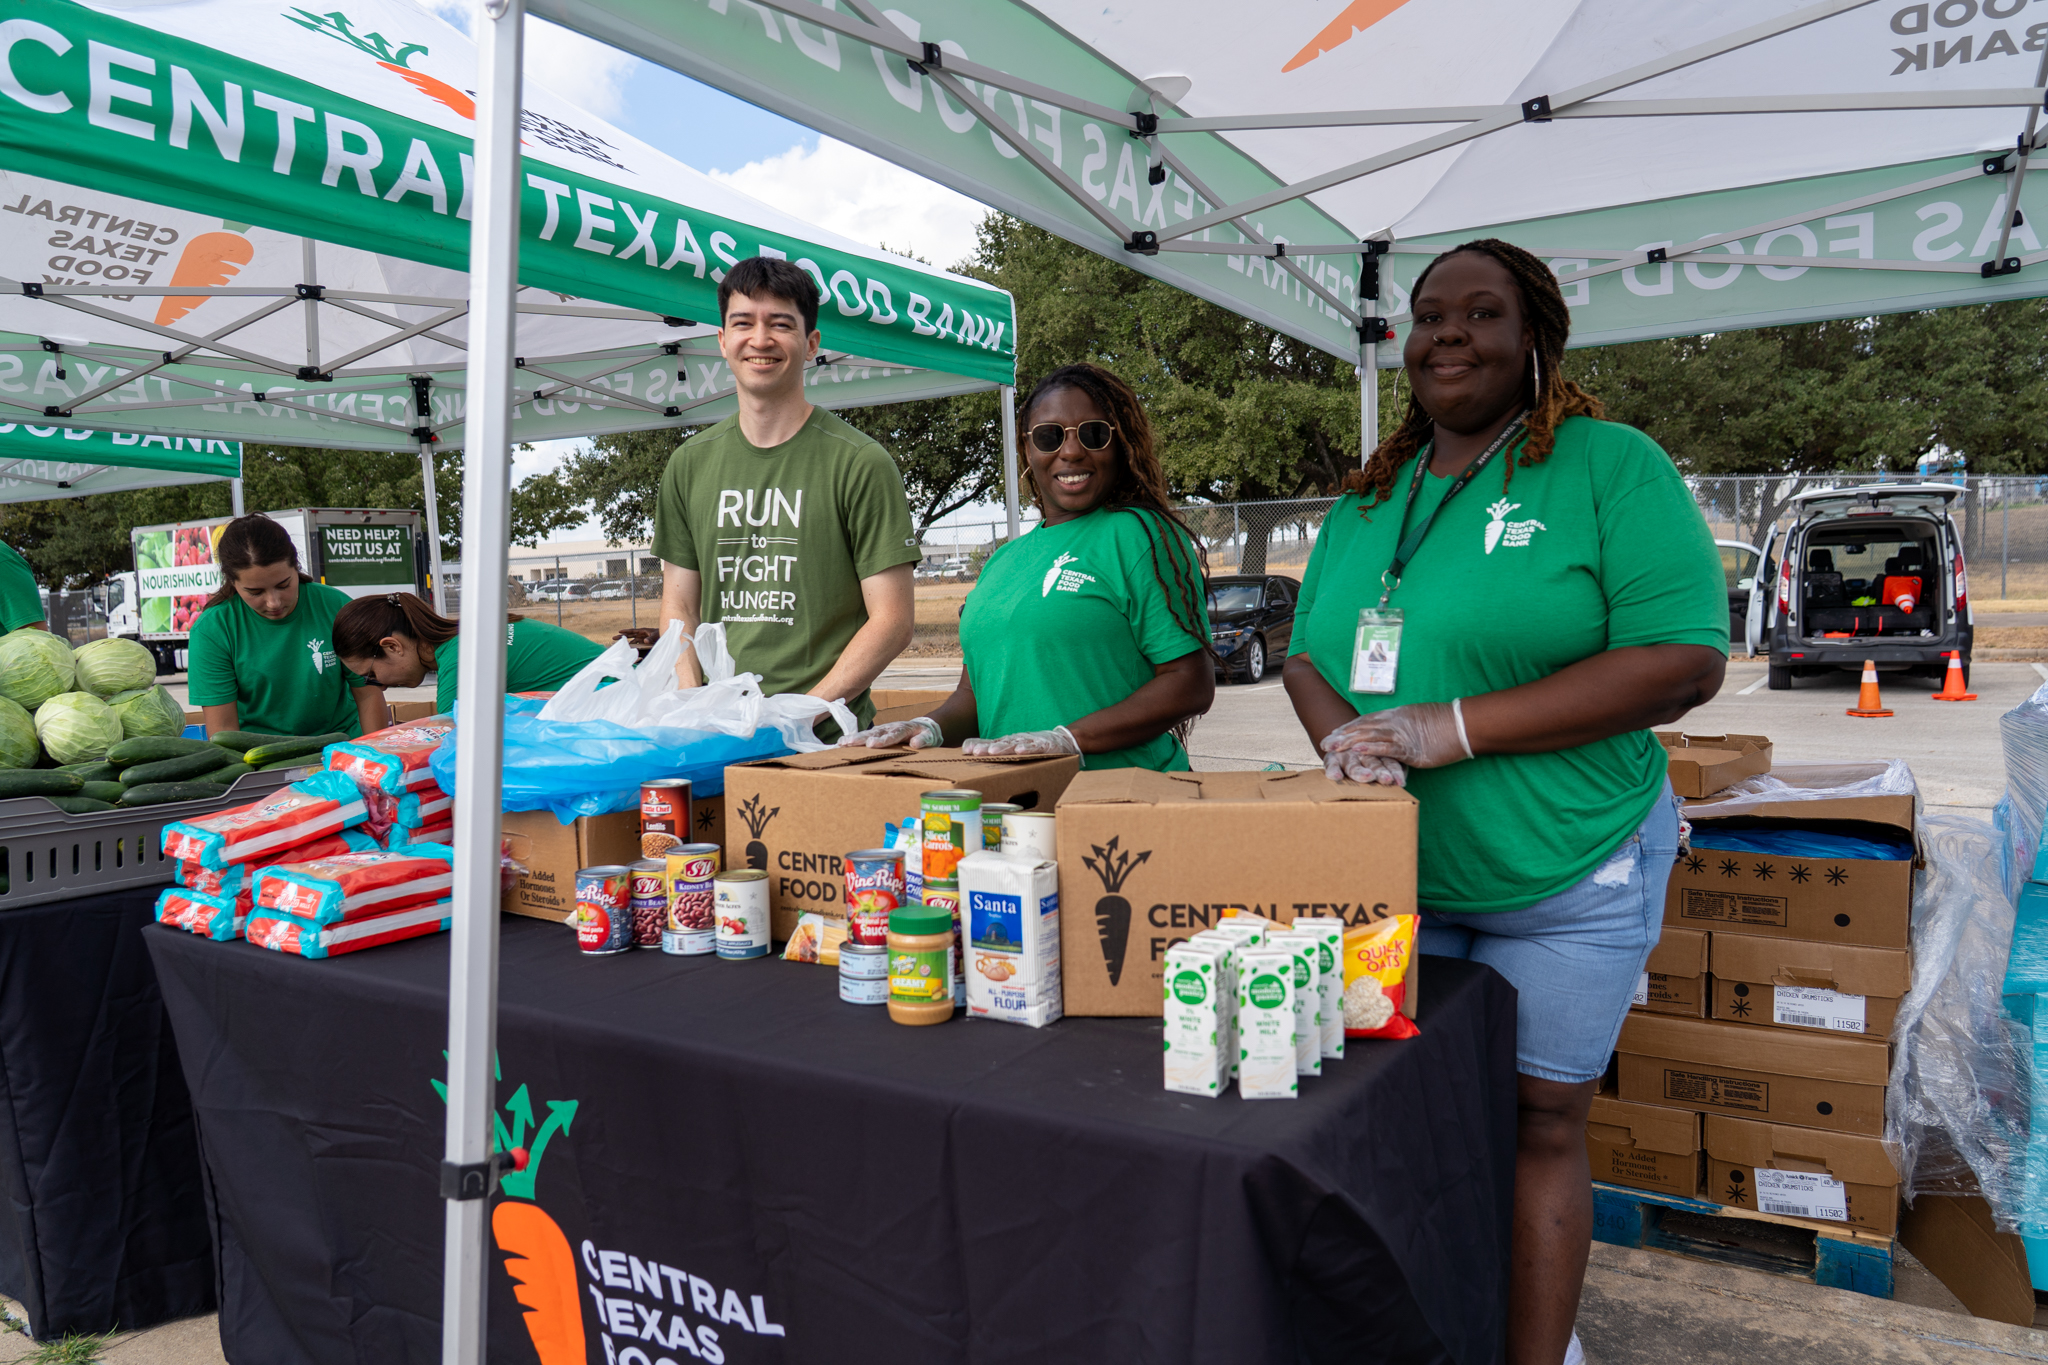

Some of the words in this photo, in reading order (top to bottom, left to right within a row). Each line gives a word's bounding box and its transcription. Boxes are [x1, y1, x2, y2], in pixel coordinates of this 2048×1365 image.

[526, 172, 738, 283] TEXAS
[759, 244, 898, 325] OOD
[717, 487, 803, 529] RUN
[1506, 525, 1535, 534] TEXAS
[1507, 519, 1547, 531] CENTRAL
[326, 528, 362, 540] NEED
[363, 528, 401, 541] HELP?
[751, 532, 768, 549] to
[1503, 532, 1531, 541] FOOD
[327, 542, 363, 556] VISIT
[365, 542, 384, 555] US
[386, 542, 402, 555] AT
[1502, 539, 1529, 547] BANK
[717, 555, 798, 583] FIGHT
[1062, 569, 1096, 583] CENTRAL
[142, 572, 203, 590] NOURISHING
[204, 570, 222, 586] LIV
[1058, 579, 1081, 589] FOOD
[1060, 574, 1085, 585] TEXAS
[1056, 585, 1079, 593] BANK
[720, 590, 796, 611] HUNGER
[656, 805, 670, 813] Chef
[646, 822, 666, 831] Lentils
[925, 830, 951, 841] Sliced
[924, 840, 953, 851] Carrots
[778, 850, 845, 876] CENTR
[532, 870, 555, 883] Added
[845, 872, 875, 892] Vine
[875, 869, 905, 892] Ripe
[519, 878, 556, 894] Hormones
[779, 877, 837, 902] FOOD
[520, 890, 530, 901] Or
[531, 893, 560, 906] Steroids
[586, 884, 618, 906] Ripe
[1687, 889, 1703, 897] Safe
[1704, 891, 1735, 901] Handling
[1736, 894, 1779, 904] Instructions
[974, 894, 1017, 915] Santa
[1148, 903, 1286, 928] CENTAL
[860, 924, 888, 936] Sauce
[1357, 940, 1406, 964] QUICK
[1367, 954, 1401, 973] OATS
[892, 977, 927, 989] CREAMY
[1648, 972, 1667, 982] ded
[994, 996, 1027, 1010] FLOUR
[1776, 991, 1799, 999] CHICKEN
[1801, 993, 1834, 1002] DRUMSTICKS
[1836, 1019, 1861, 1031] 11502
[1687, 1073, 1718, 1083] Handling
[1718, 1077, 1760, 1088] Instructions
[1612, 1149, 1624, 1158] No
[1628, 1152, 1656, 1163] Added
[1612, 1158, 1656, 1171] Hormones
[1612, 1166, 1624, 1175] Or
[1625, 1169, 1661, 1181] Steroids
[1758, 1181, 1781, 1189] CHICKEN
[1782, 1183, 1814, 1192] DRUMSTICKS
[1819, 1208, 1844, 1218] 11502
[581, 1239, 786, 1337] CENTRAL
[588, 1284, 725, 1365] TEXAS
